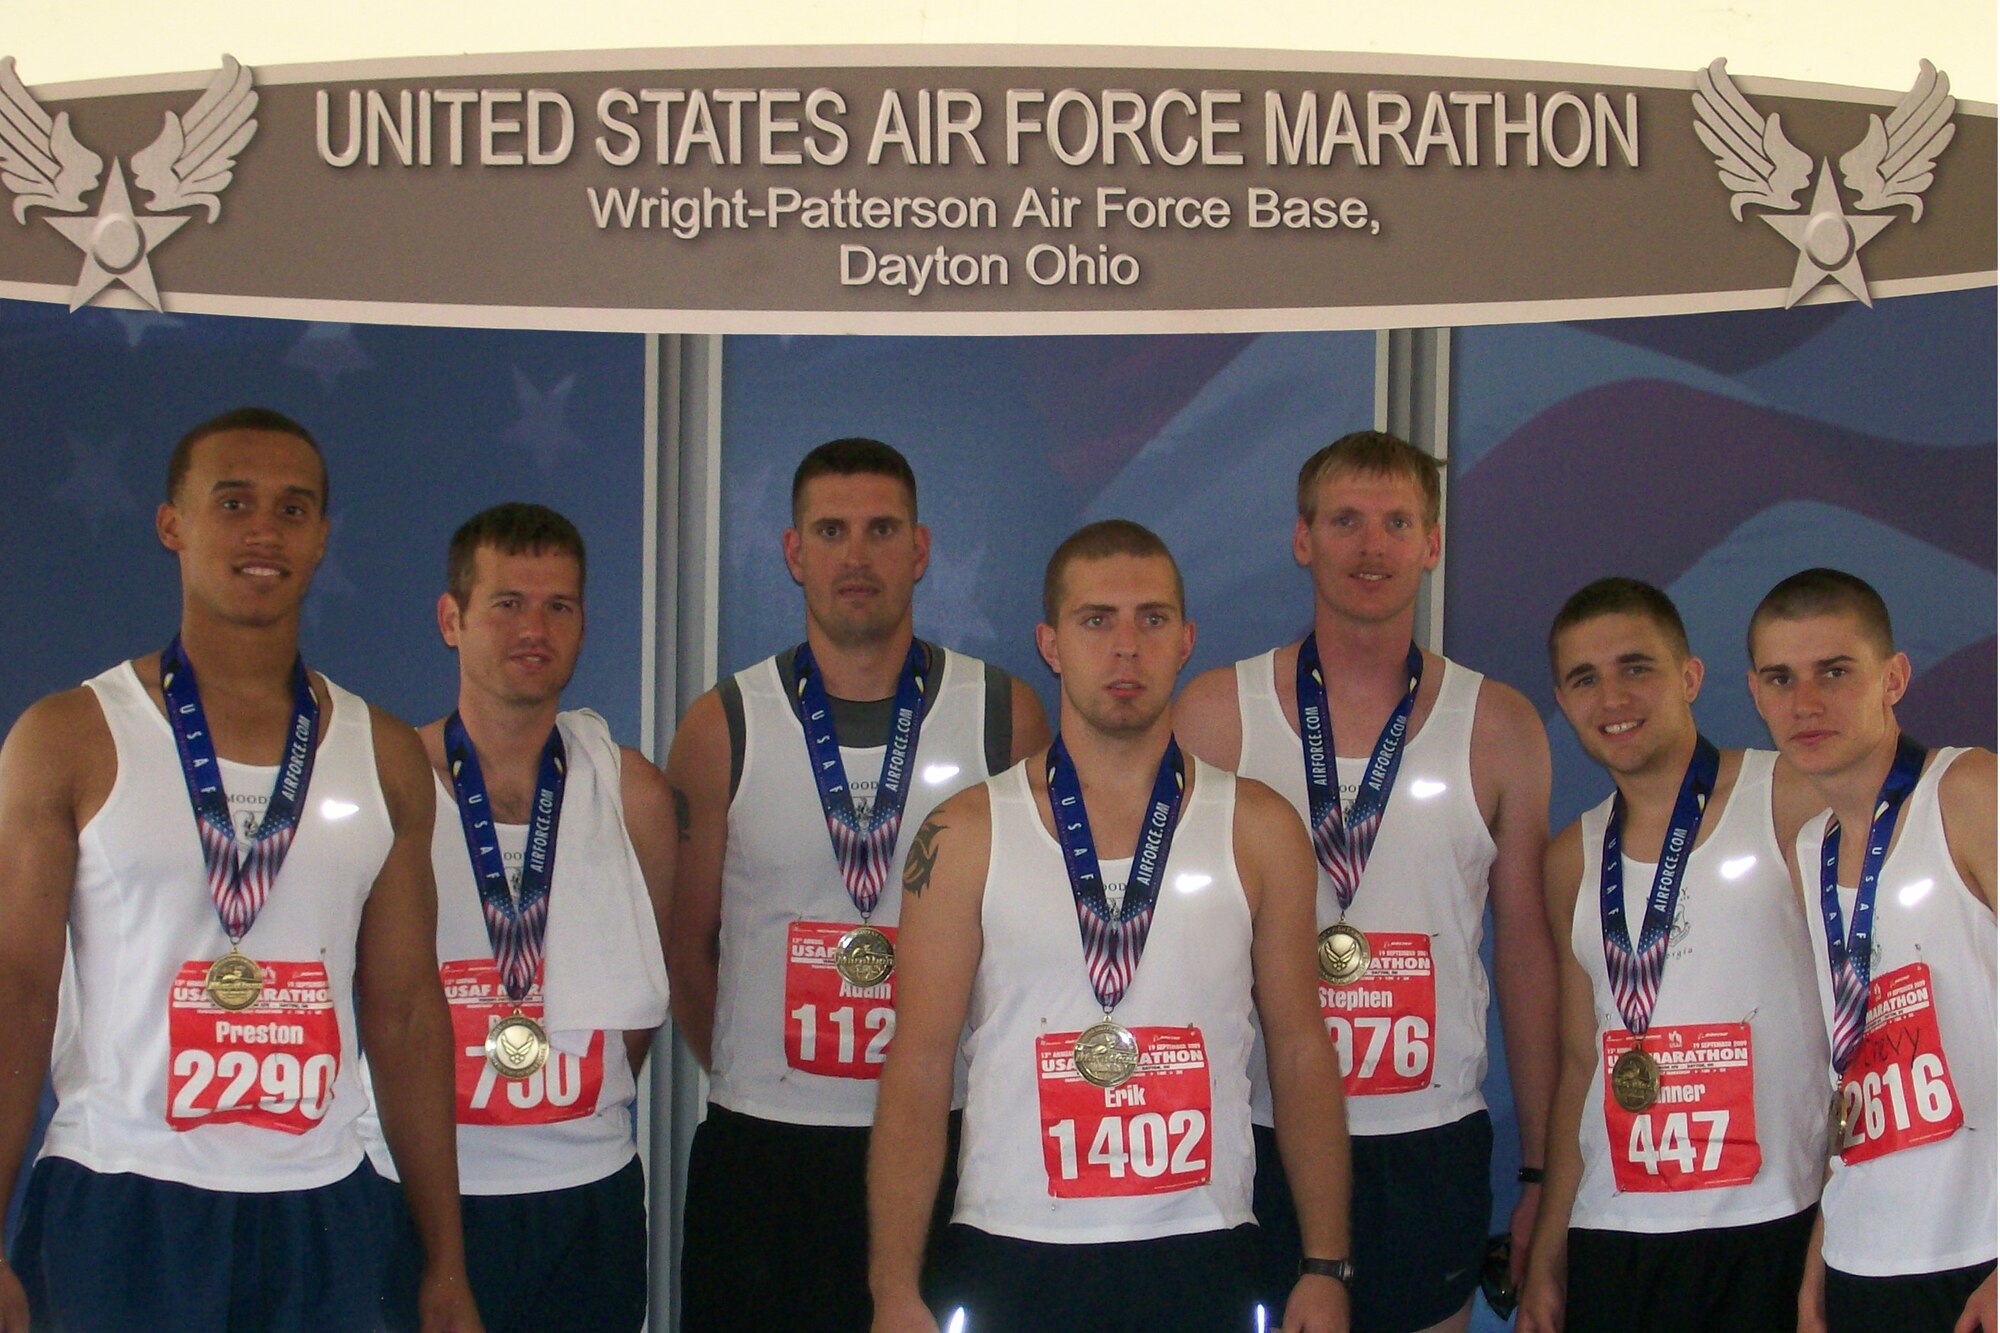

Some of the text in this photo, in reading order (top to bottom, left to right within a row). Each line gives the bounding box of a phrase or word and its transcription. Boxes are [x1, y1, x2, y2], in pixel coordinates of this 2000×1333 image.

[316, 88, 1640, 168] UNITED STATES AIR FORCE MARATHON
[587, 187, 1381, 240] Wright-Patterson Air Force Base,
[839, 243, 1140, 297] Dayton Ohio
[281, 713, 312, 802] AIRFORCE.COM
[885, 707, 913, 793] AIRFORCE.COM
[1304, 705, 1328, 786] AIRFORCE.COM
[1368, 714, 1407, 791] AIRFORCE.COM
[227, 794, 268, 805] MOOD
[530, 788, 554, 873] AIRFORCE.COM
[1136, 801, 1170, 886] AIRFORCE.COM
[1653, 827, 1689, 913] AIRFORCE.COM
[792, 944, 837, 958] USAF
[1369, 957, 1431, 970] ATHON
[173, 987, 329, 1003] USA RATHO
[444, 984, 492, 998] USAF
[1318, 986, 1393, 1012] Stephen
[215, 1020, 305, 1045] Preston
[791, 1004, 897, 1064] 112
[1041, 1059, 1076, 1073] USA
[1139, 1050, 1205, 1066] ATHON
[1324, 1015, 1430, 1079] 976
[171, 1048, 337, 1121] 2290
[1104, 1083, 1147, 1108] Erik
[1653, 1083, 1706, 1104] nner
[1843, 1053, 1953, 1149] 2616
[1048, 1109, 1207, 1181] 1402
[1628, 1109, 1730, 1176] 447
